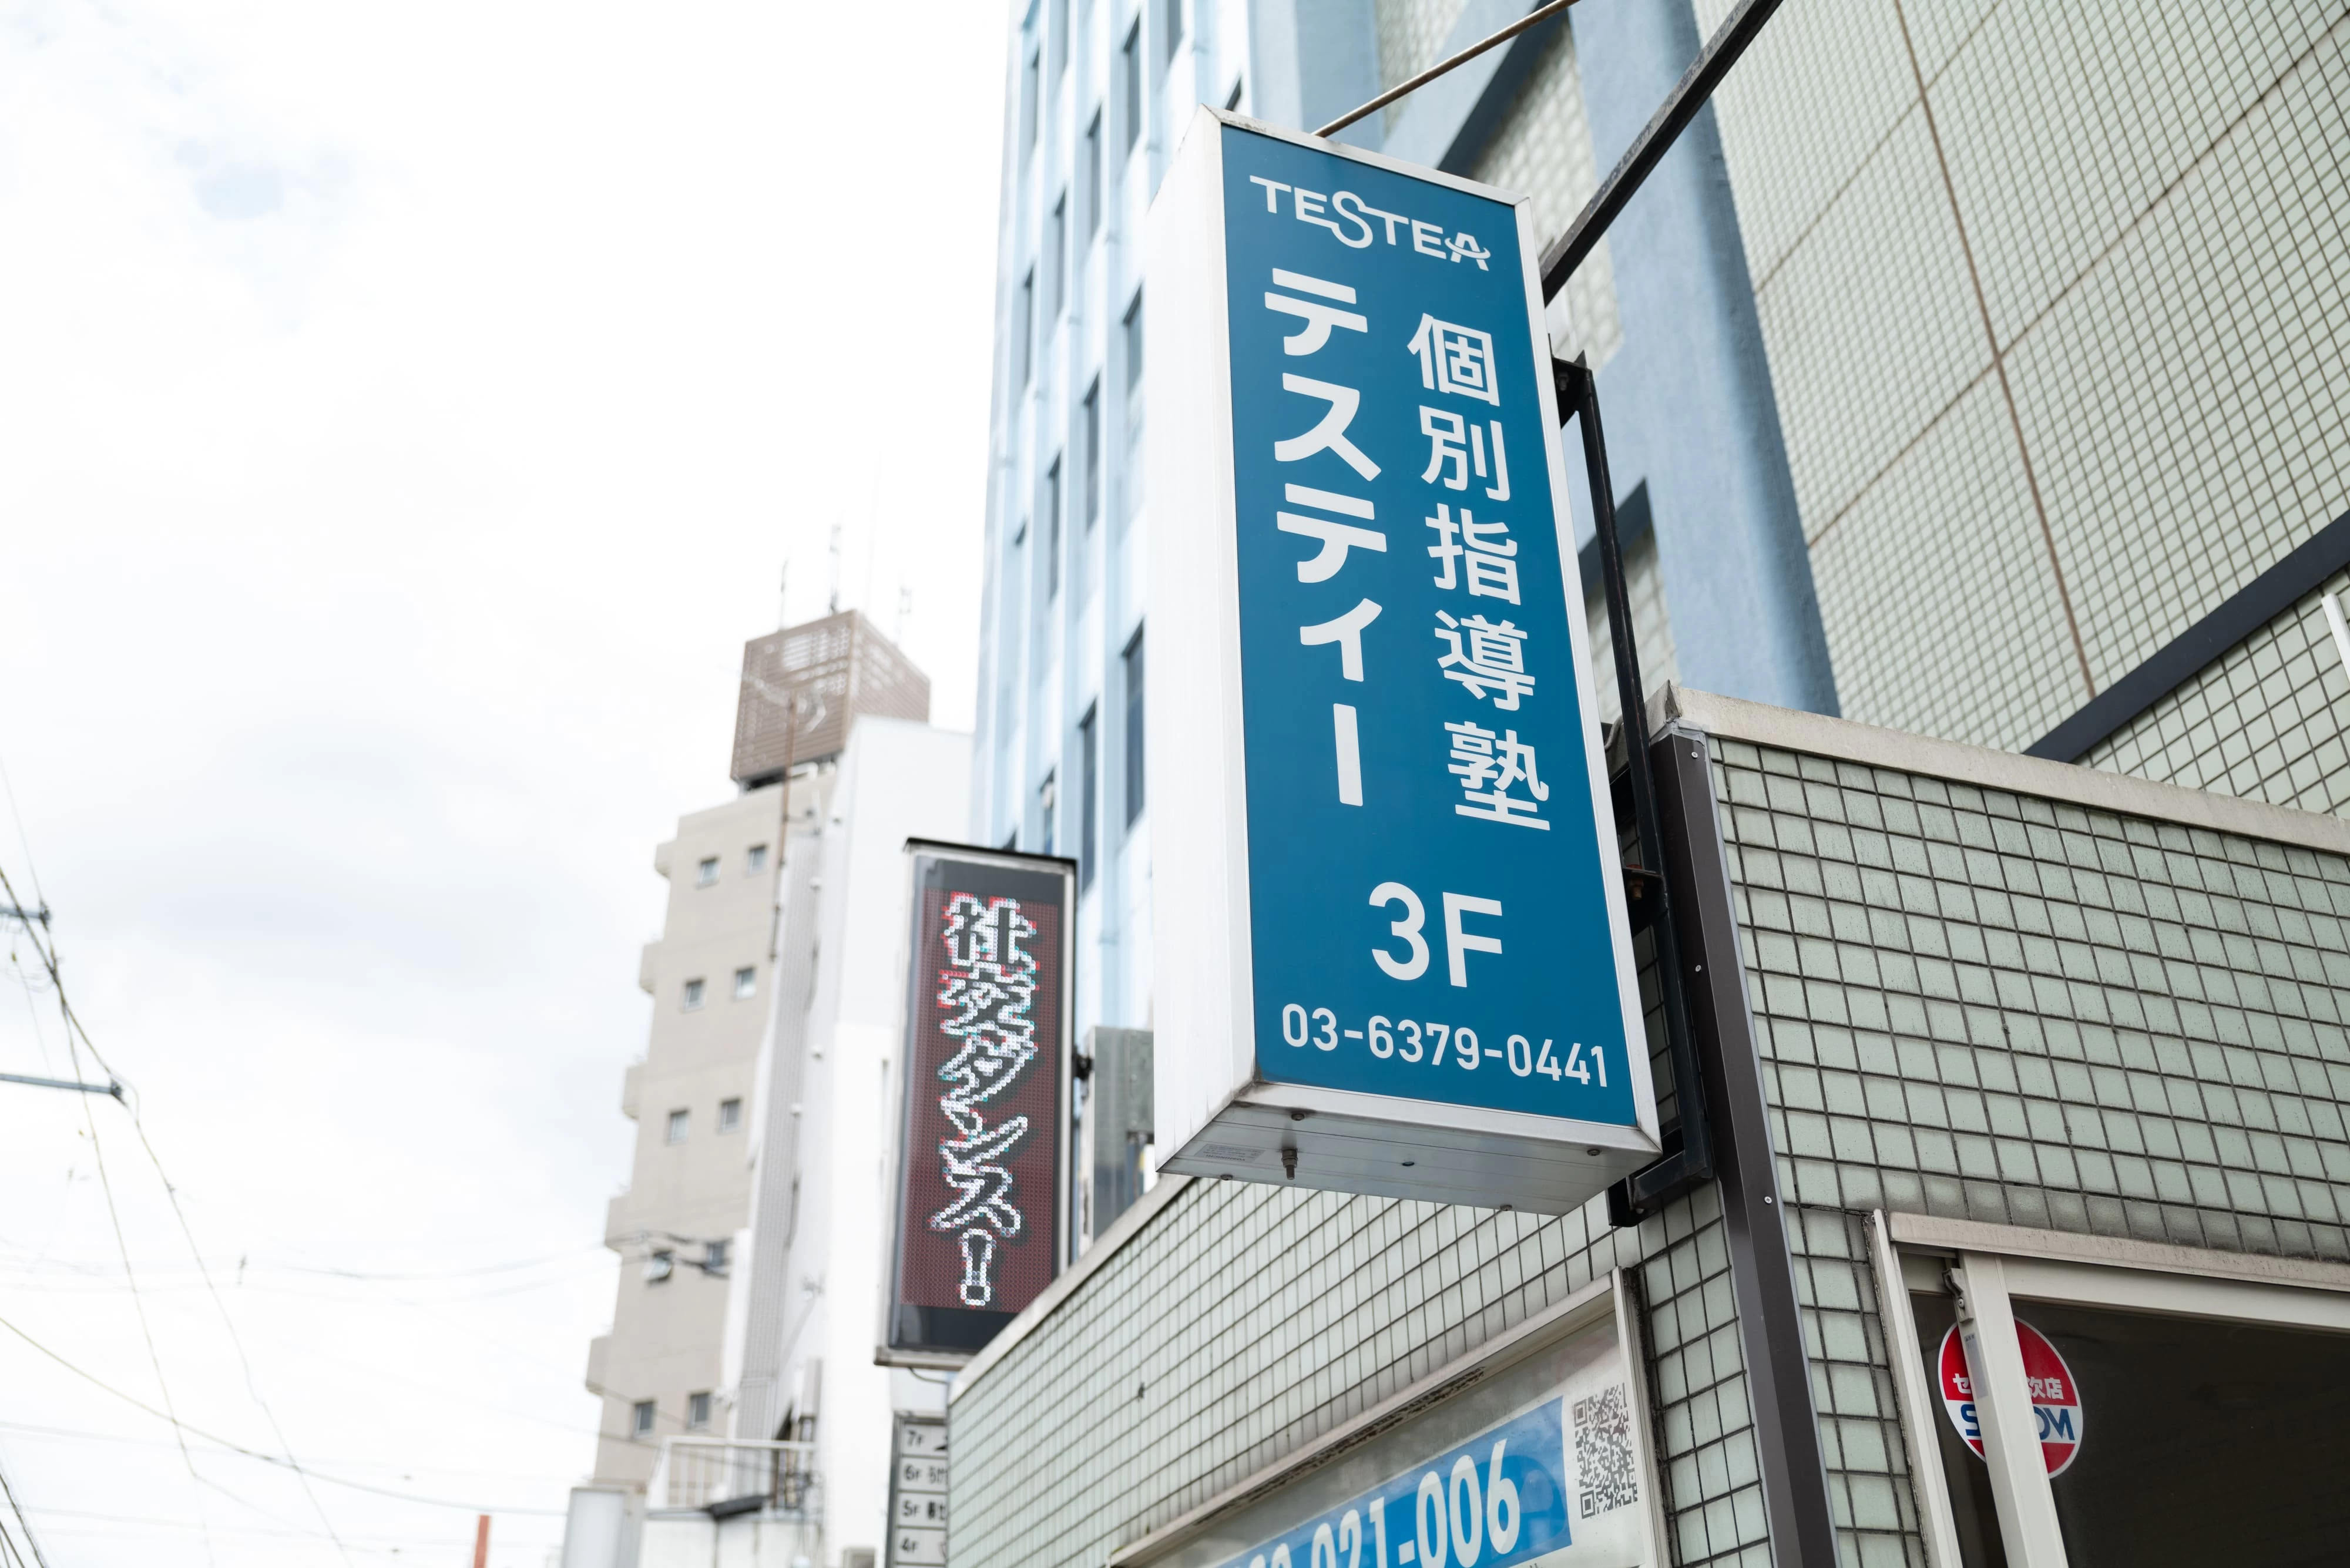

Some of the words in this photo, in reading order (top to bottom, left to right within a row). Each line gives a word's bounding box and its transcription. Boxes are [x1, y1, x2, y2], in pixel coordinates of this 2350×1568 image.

[1250, 175, 1490, 271] TESTEA
[1265, 268, 1387, 806] テスティー
[1407, 313, 1550, 831] 個別指導塾
[1369, 882, 1502, 988] 3F
[1283, 1003, 1607, 1087] 03-6379-0441
